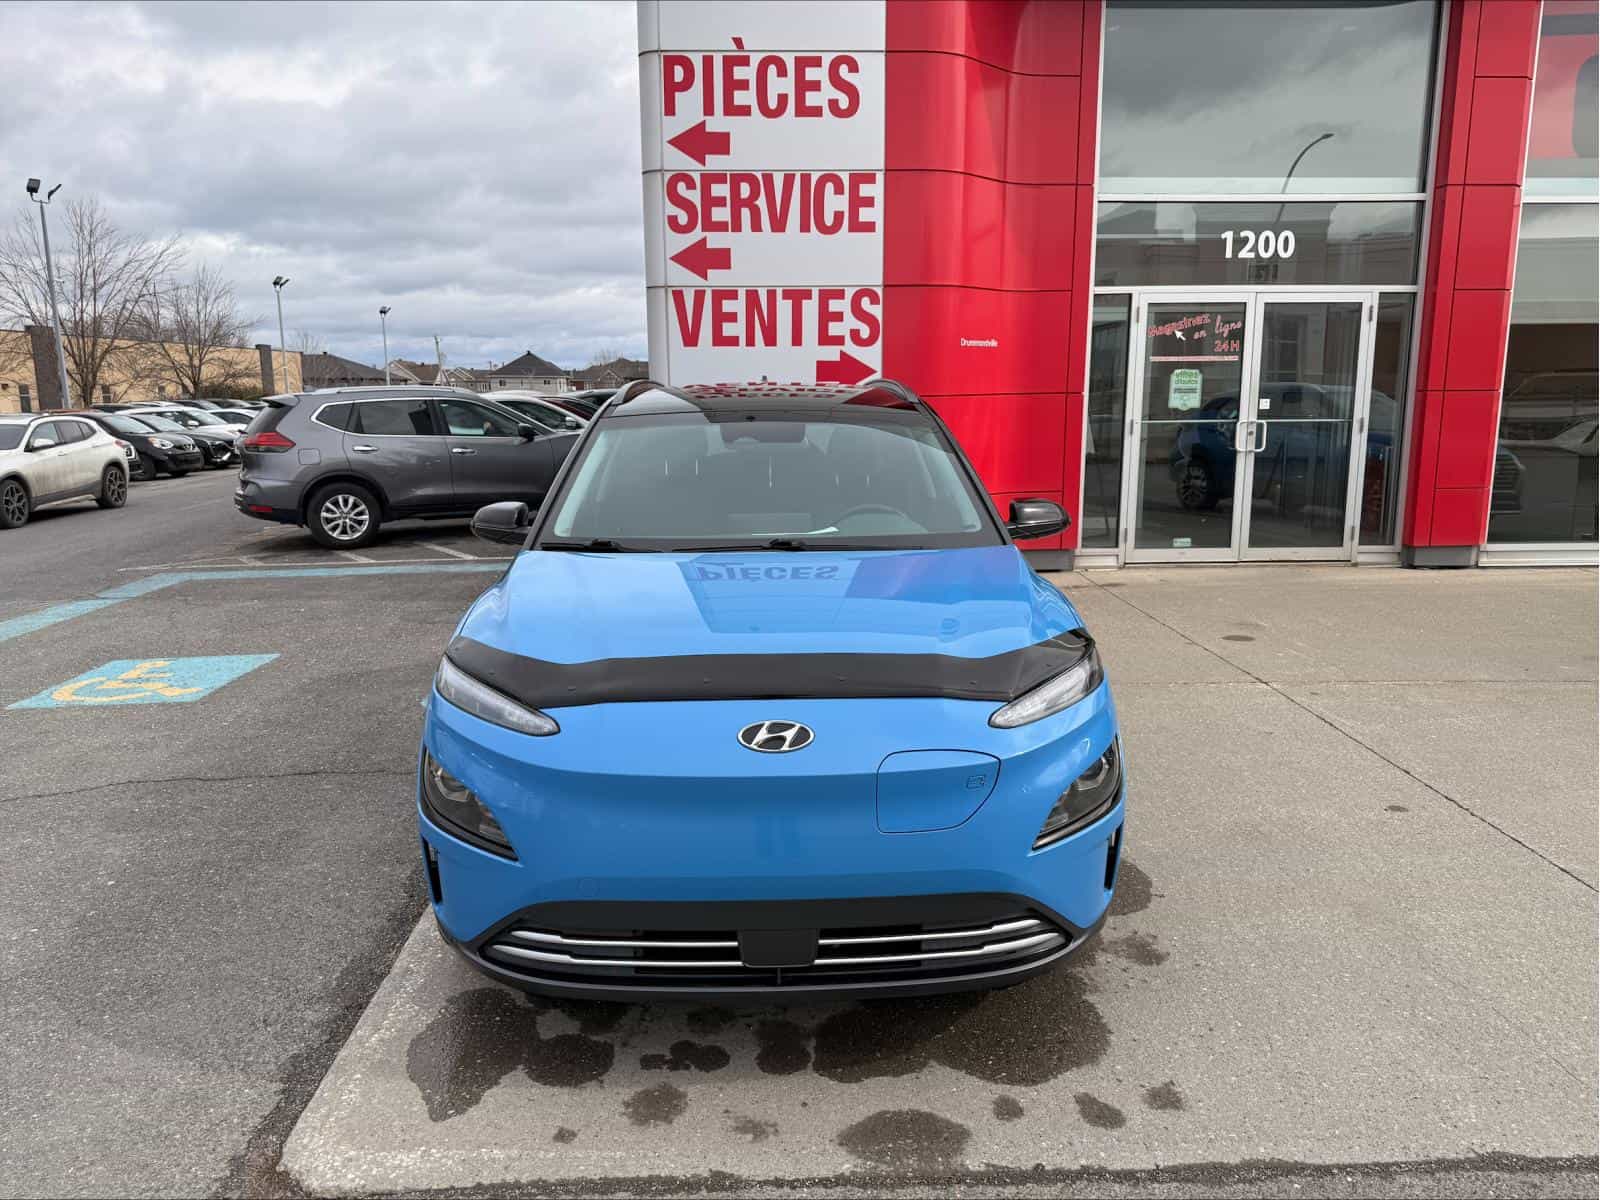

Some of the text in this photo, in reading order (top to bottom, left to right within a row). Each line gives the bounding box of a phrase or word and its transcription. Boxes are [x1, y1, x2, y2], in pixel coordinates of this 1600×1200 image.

[663, 37, 860, 119] PIÈCES
[666, 172, 877, 236] SERVICE
[1221, 230, 1296, 258] 1200
[672, 287, 881, 348] VENTES
